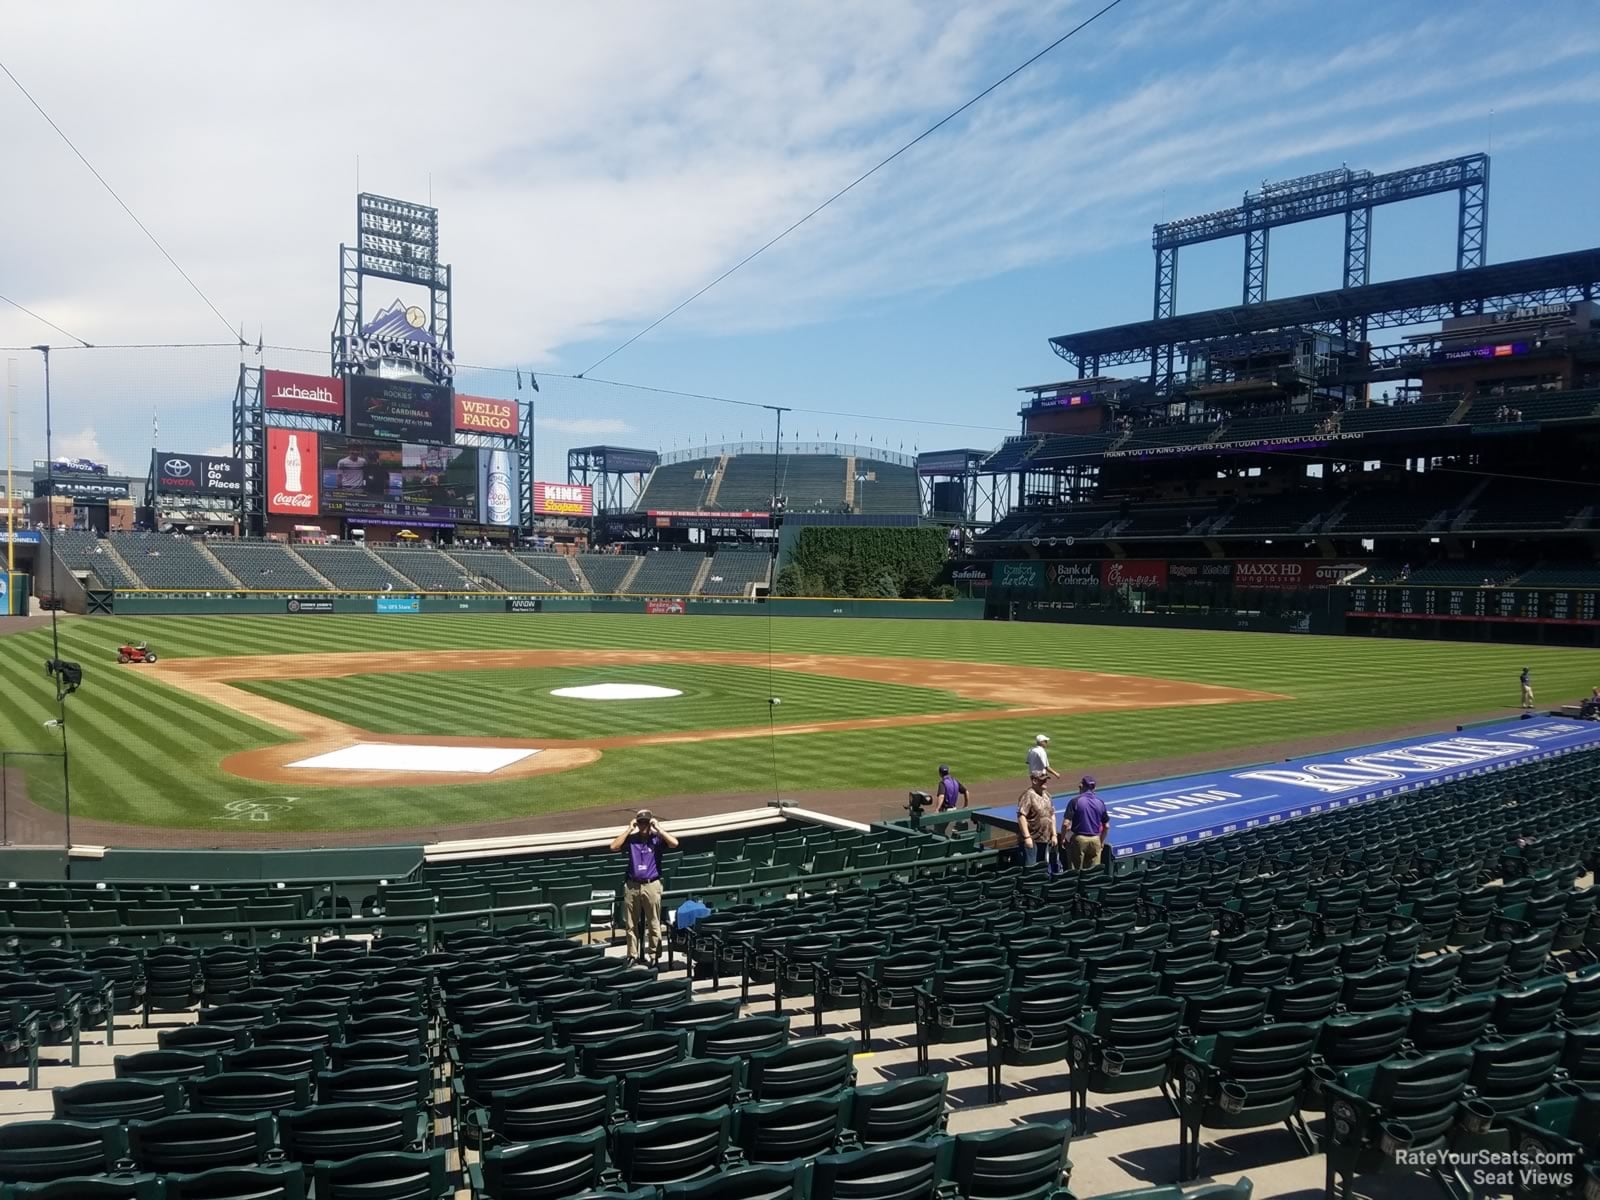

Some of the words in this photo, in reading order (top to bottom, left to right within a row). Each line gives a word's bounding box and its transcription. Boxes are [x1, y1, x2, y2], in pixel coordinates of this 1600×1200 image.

[342, 335, 456, 377] ROCKIES
[1445, 350, 1471, 359] THANK
[277, 384, 333, 402] uchealth
[391, 407, 429, 418] CARDINALS
[462, 400, 511, 417] WELLS
[370, 415, 404, 424] TOMORROW
[462, 413, 510, 429] FARGO
[1156, 447, 1175, 455] KING
[66, 463, 93, 471] TOYOTA
[207, 462, 231, 472] Let's
[207, 471, 222, 479] Go
[160, 478, 196, 486] TOYOTA
[207, 480, 240, 489] Places
[55, 483, 127, 495] TUNDRA
[544, 485, 583, 501] KING
[543, 499, 584, 515] Soopers
[1057, 564, 1079, 574] Bank
[1081, 563, 1092, 574] of
[1236, 563, 1278, 575] MAXX
[1281, 564, 1302, 575] HD
[951, 570, 987, 579] Safelite
[1002, 573, 1034, 586] dental
[1057, 575, 1099, 585] Colorado
[1107, 565, 1160, 586] Chick-fil-A
[1231, 737, 1540, 793] ROCKIES
[1107, 789, 1243, 820] COLORADO
